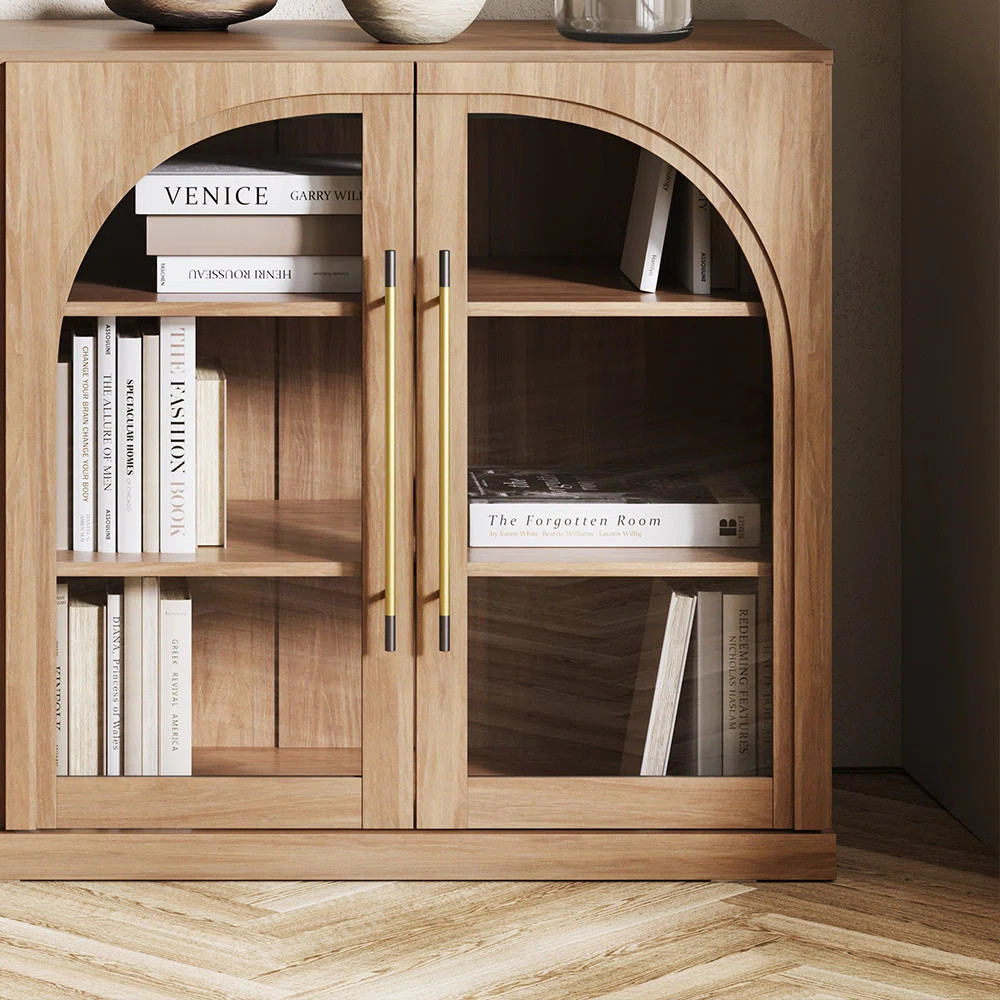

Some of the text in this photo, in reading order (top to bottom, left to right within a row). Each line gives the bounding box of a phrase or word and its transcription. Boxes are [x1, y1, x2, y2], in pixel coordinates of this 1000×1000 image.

[164, 186, 268, 205] VENICE
[290, 190, 331, 201] GARRY
[188, 269, 292, 279] HENRI ROUSSEAU
[103, 373, 112, 492] THE ALLURE OF MEN
[126, 379, 134, 476] SPECTACULAR HOMES
[170, 327, 185, 536] THE FASHION BOOK
[488, 515, 661, 529] The Forgotten Room
[112, 616, 120, 750] DIANA, Princess of Wales
[728, 635, 737, 730] NICHOLAS HASLAM
[739, 609, 748, 755] REDEEMING FEATURES
